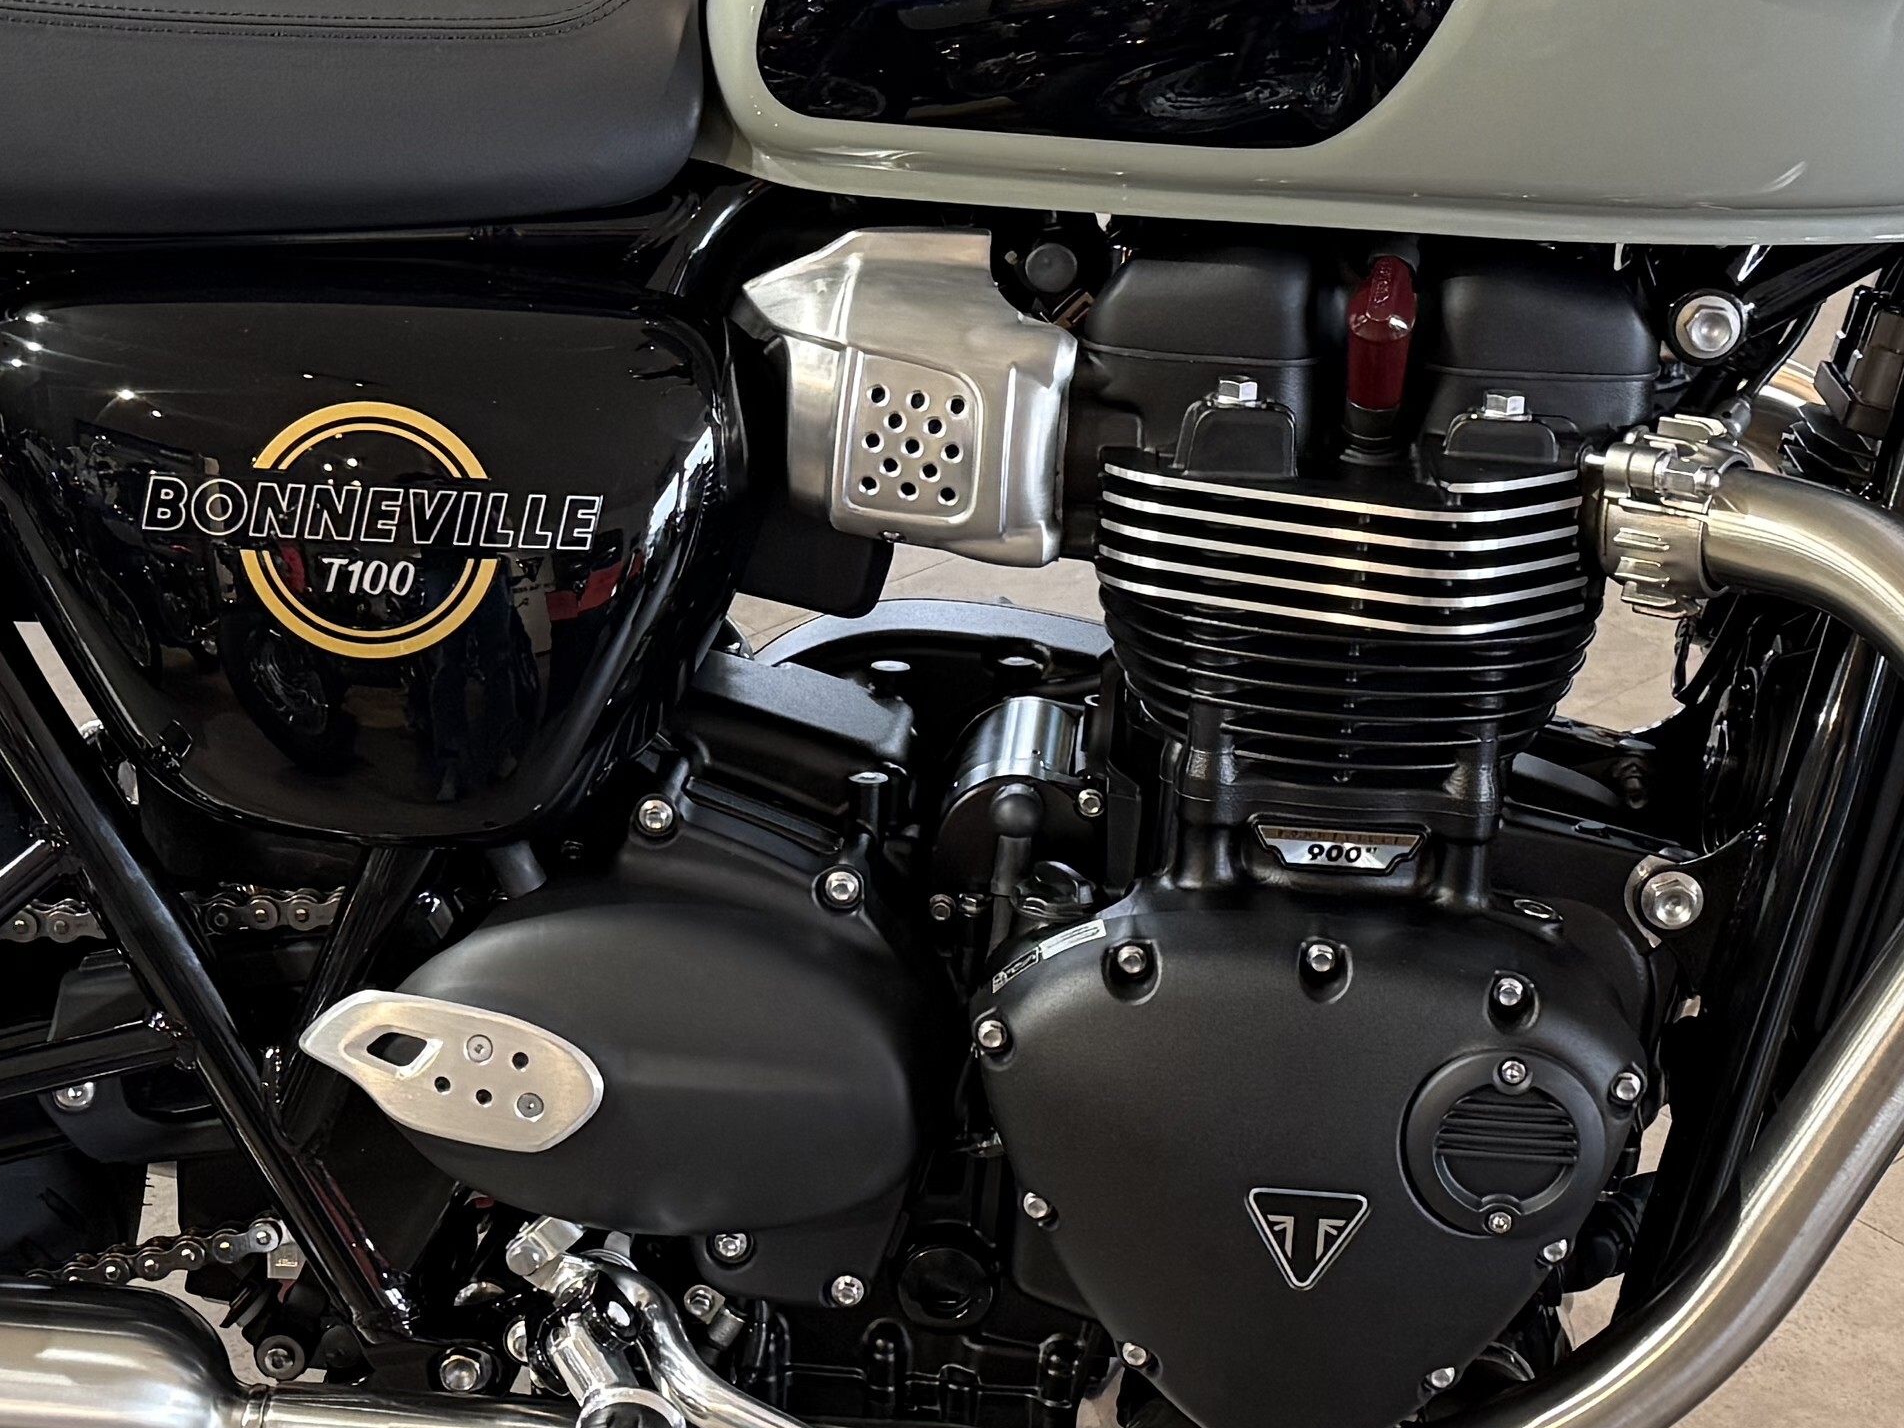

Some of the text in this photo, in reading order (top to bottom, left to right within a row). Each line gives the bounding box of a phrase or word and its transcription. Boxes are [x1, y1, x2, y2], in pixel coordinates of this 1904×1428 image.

[141, 474, 603, 550] BONNEVILLE
[322, 557, 415, 596] T100
[1308, 844, 1362, 863] 900
